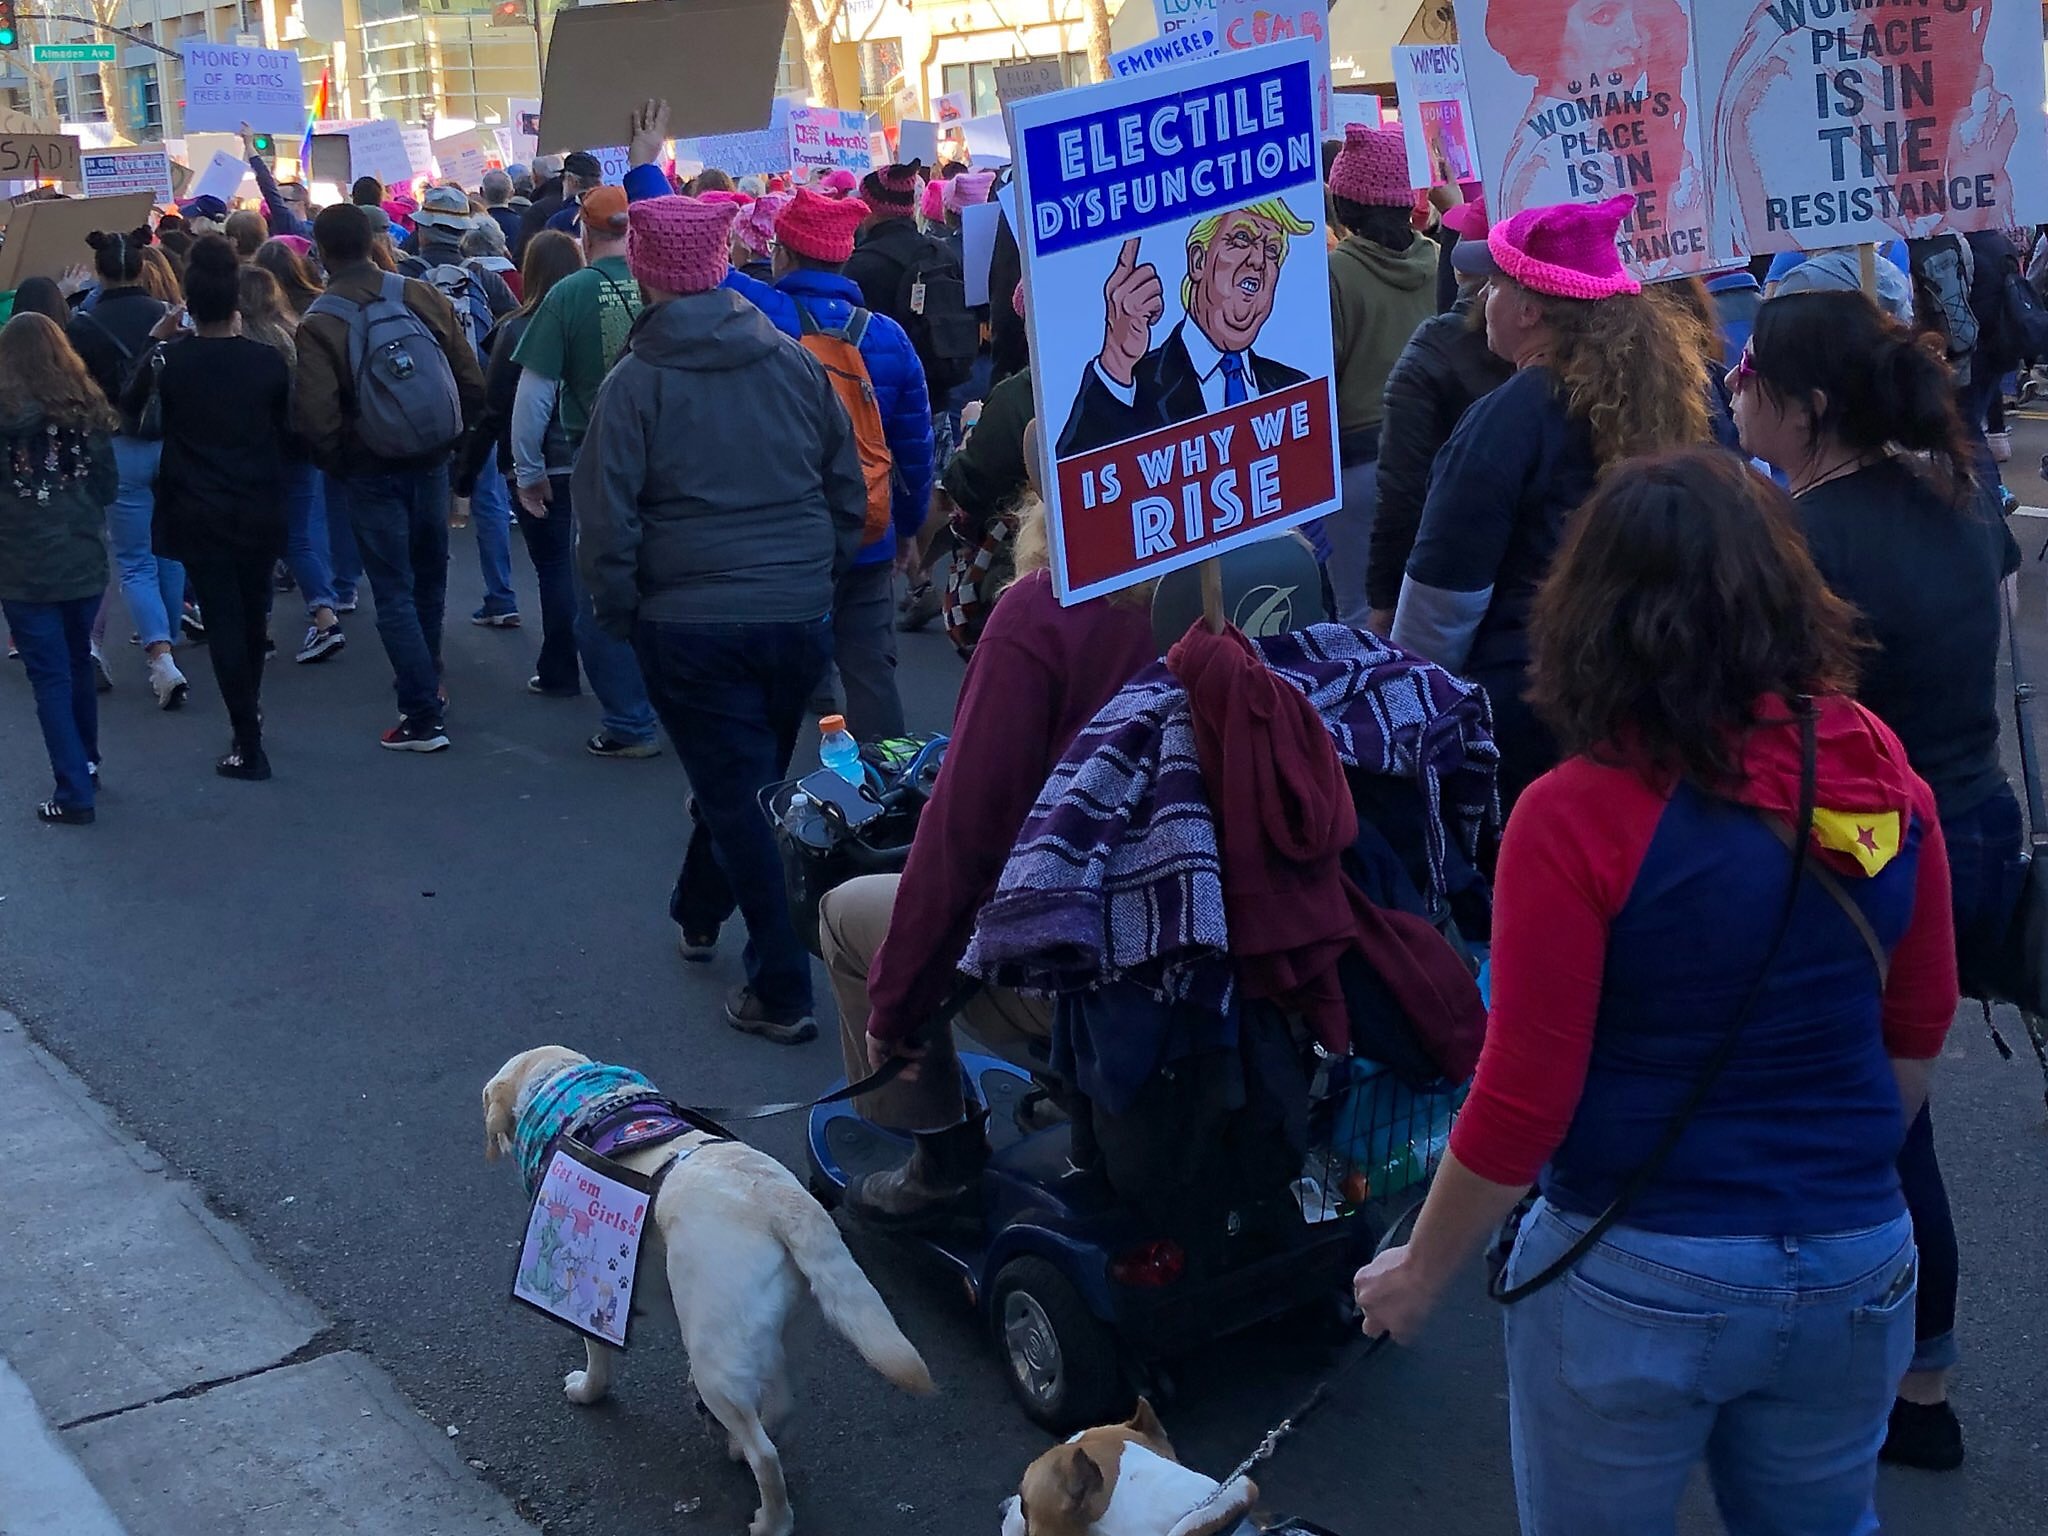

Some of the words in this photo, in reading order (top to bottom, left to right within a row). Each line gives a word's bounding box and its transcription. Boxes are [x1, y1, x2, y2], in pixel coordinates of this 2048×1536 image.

[40, 49, 84, 58] Almaden
[91, 49, 110, 58] Ave
[192, 50, 251, 67] MONEY
[257, 54, 289, 69] OUT
[1117, 30, 1214, 76] EMPOWERED
[1811, 16, 1933, 64] PLACE
[193, 90, 220, 101] FREE
[204, 73, 222, 85] OF
[235, 72, 284, 88] POLITICS
[1590, 72, 1600, 88] A
[1816, 68, 1864, 119] IS
[1882, 60, 1935, 111] IN
[1058, 79, 1285, 182] ELECTILE
[1527, 90, 1671, 140] WOMAN'S
[0, 140, 74, 171] SAD!
[1561, 120, 1648, 159] PLACE
[1818, 117, 1939, 181] THE
[1036, 133, 1311, 240] DYSFUNCTION
[1567, 159, 1604, 197] IS
[1614, 150, 1654, 189] IN
[1766, 173, 1996, 232] RESISTANCE
[1618, 227, 1706, 264] TANCE
[1081, 463, 1122, 509] IS
[1137, 425, 1235, 489] WHY
[1250, 400, 1310, 451] WE
[1131, 455, 1282, 560] RISE
[552, 1161, 572, 1183] Get
[576, 1174, 601, 1199] 'em
